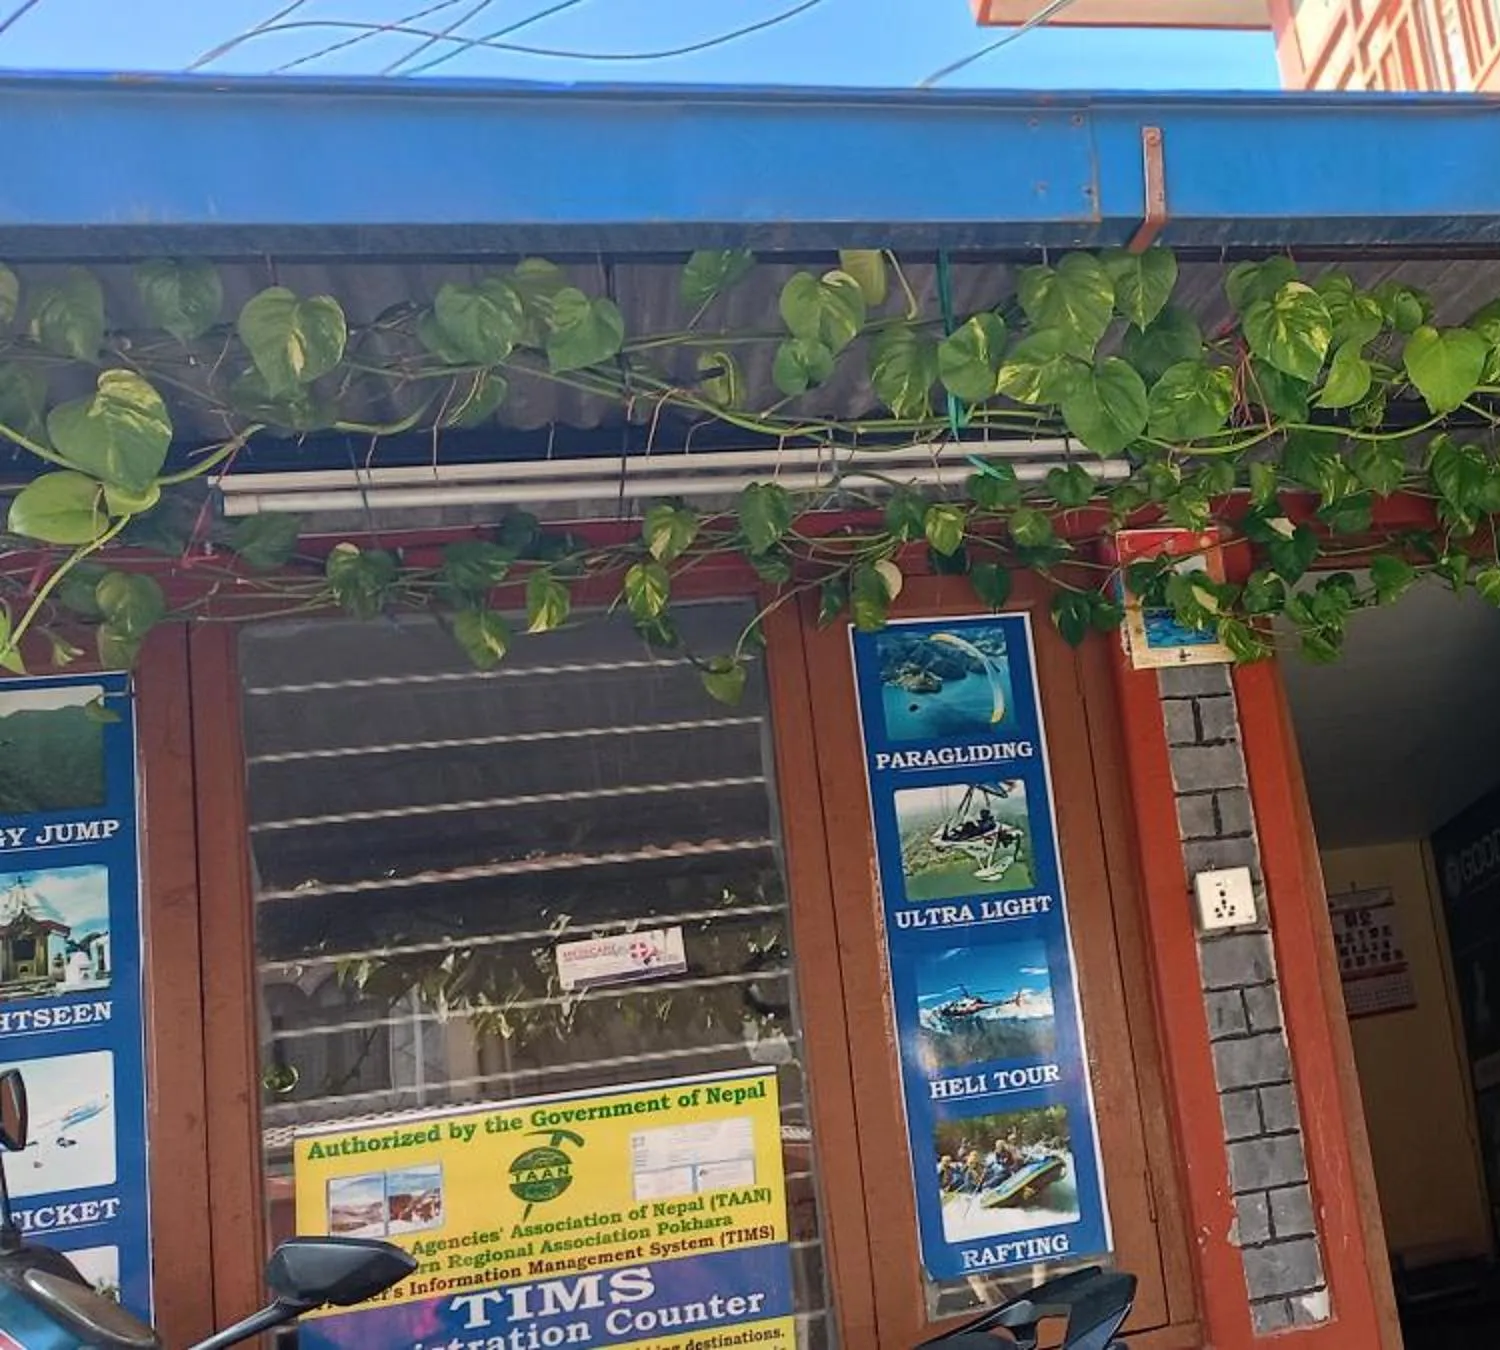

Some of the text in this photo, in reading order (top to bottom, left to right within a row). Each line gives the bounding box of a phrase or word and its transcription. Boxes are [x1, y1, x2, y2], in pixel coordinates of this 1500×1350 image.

[875, 741, 1033, 769] PARAGLIDING
[36, 820, 119, 844] JUMP
[895, 895, 1052, 928] ULTRA LIGHT
[928, 1065, 1060, 1099] HELI TOUR
[308, 1082, 766, 1160] Authorized by the Government of Nepal
[513, 1164, 569, 1183] TAAN
[411, 1188, 772, 1255] Agencies' Association of Nepal (TAAN)
[448, 1243, 533, 1268] Regional
[540, 1228, 649, 1253] Association
[657, 1214, 733, 1235] Pokhara
[961, 1234, 1069, 1268] RAFTING
[409, 1264, 521, 1296] Information
[528, 1248, 642, 1275] Management
[650, 1237, 714, 1257] System
[721, 1226, 775, 1248] (TIMS)
[450, 1267, 655, 1329] TIMS
[605, 1292, 764, 1335] Counter
